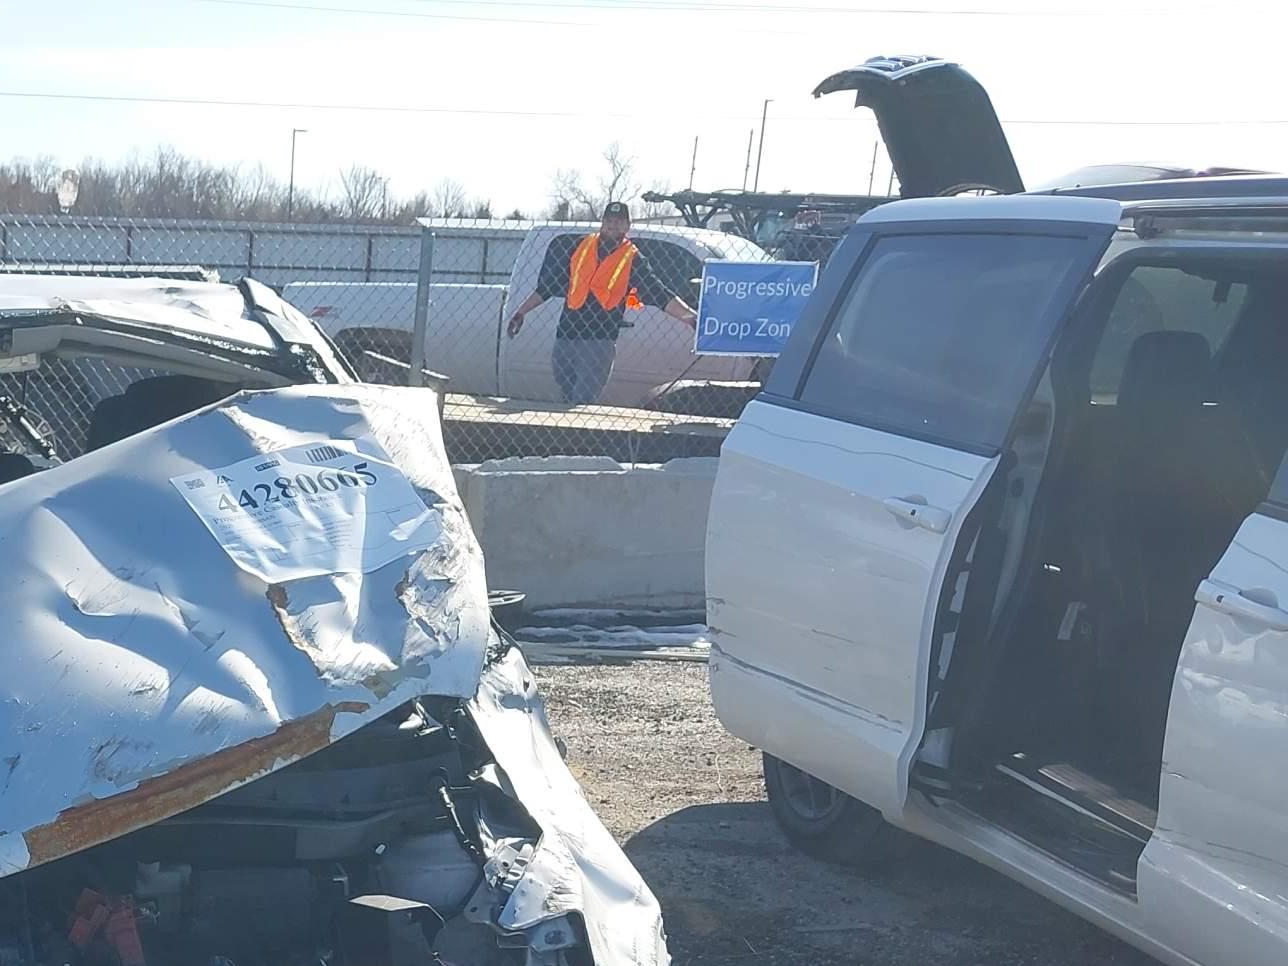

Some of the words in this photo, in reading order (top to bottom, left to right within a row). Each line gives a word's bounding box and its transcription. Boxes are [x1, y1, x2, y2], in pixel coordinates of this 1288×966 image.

[704, 276, 812, 299] Progressive
[704, 316, 751, 341] Drop
[755, 318, 791, 338] Zon
[218, 462, 377, 513] 44280665
